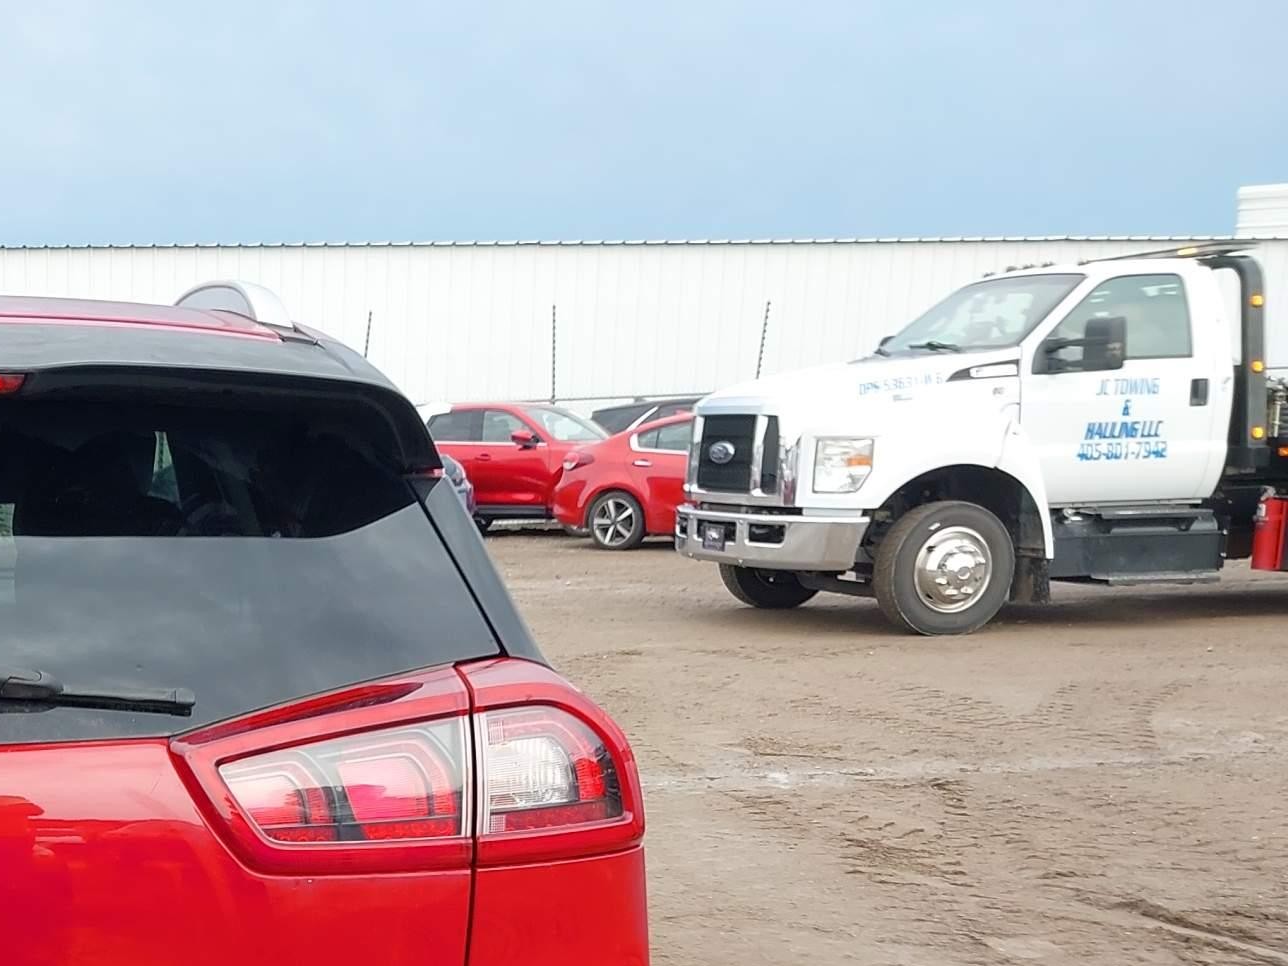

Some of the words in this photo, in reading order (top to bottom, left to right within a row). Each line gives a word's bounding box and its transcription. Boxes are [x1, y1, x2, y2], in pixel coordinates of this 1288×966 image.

[1096, 378, 1111, 396] JC
[1114, 377, 1161, 395] TOWING
[1122, 399, 1132, 416] &
[1084, 420, 1140, 440] HAULING
[1140, 420, 1164, 438] LLC
[1077, 440, 1167, 461] 405-801-7942
